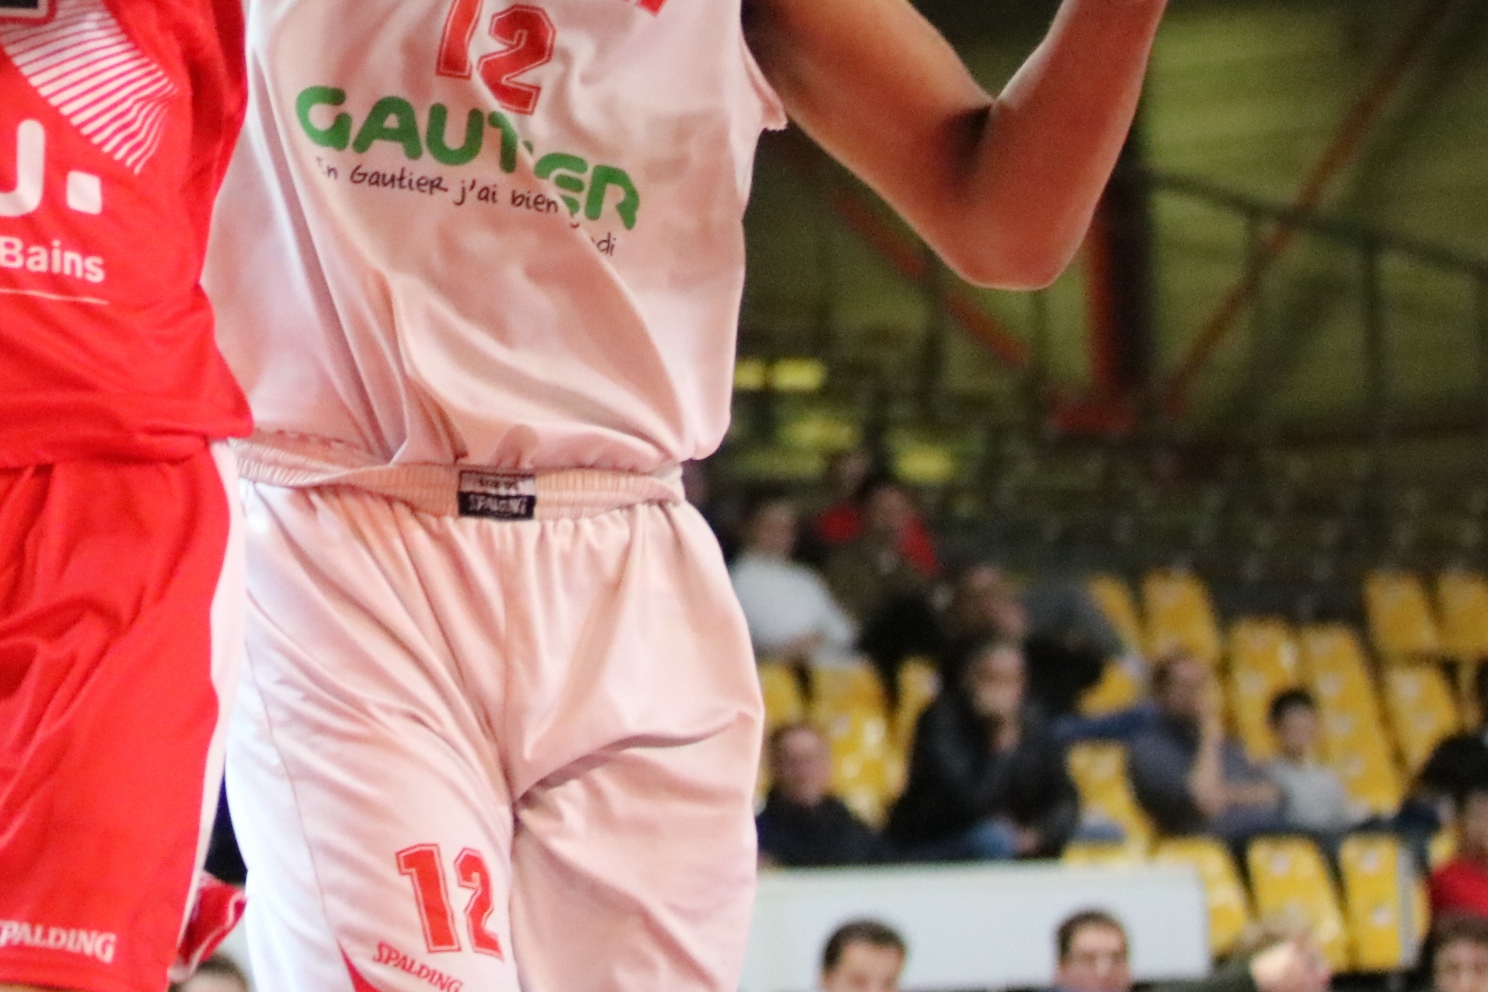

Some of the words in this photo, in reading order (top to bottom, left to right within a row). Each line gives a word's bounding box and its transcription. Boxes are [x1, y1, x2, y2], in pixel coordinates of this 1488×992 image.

[295, 85, 640, 230] GAUTER
[453, 179, 498, 206] j'ai
[512, 188, 559, 214] bien
[395, 843, 505, 962] 12
[373, 941, 464, 992] SPALDING
